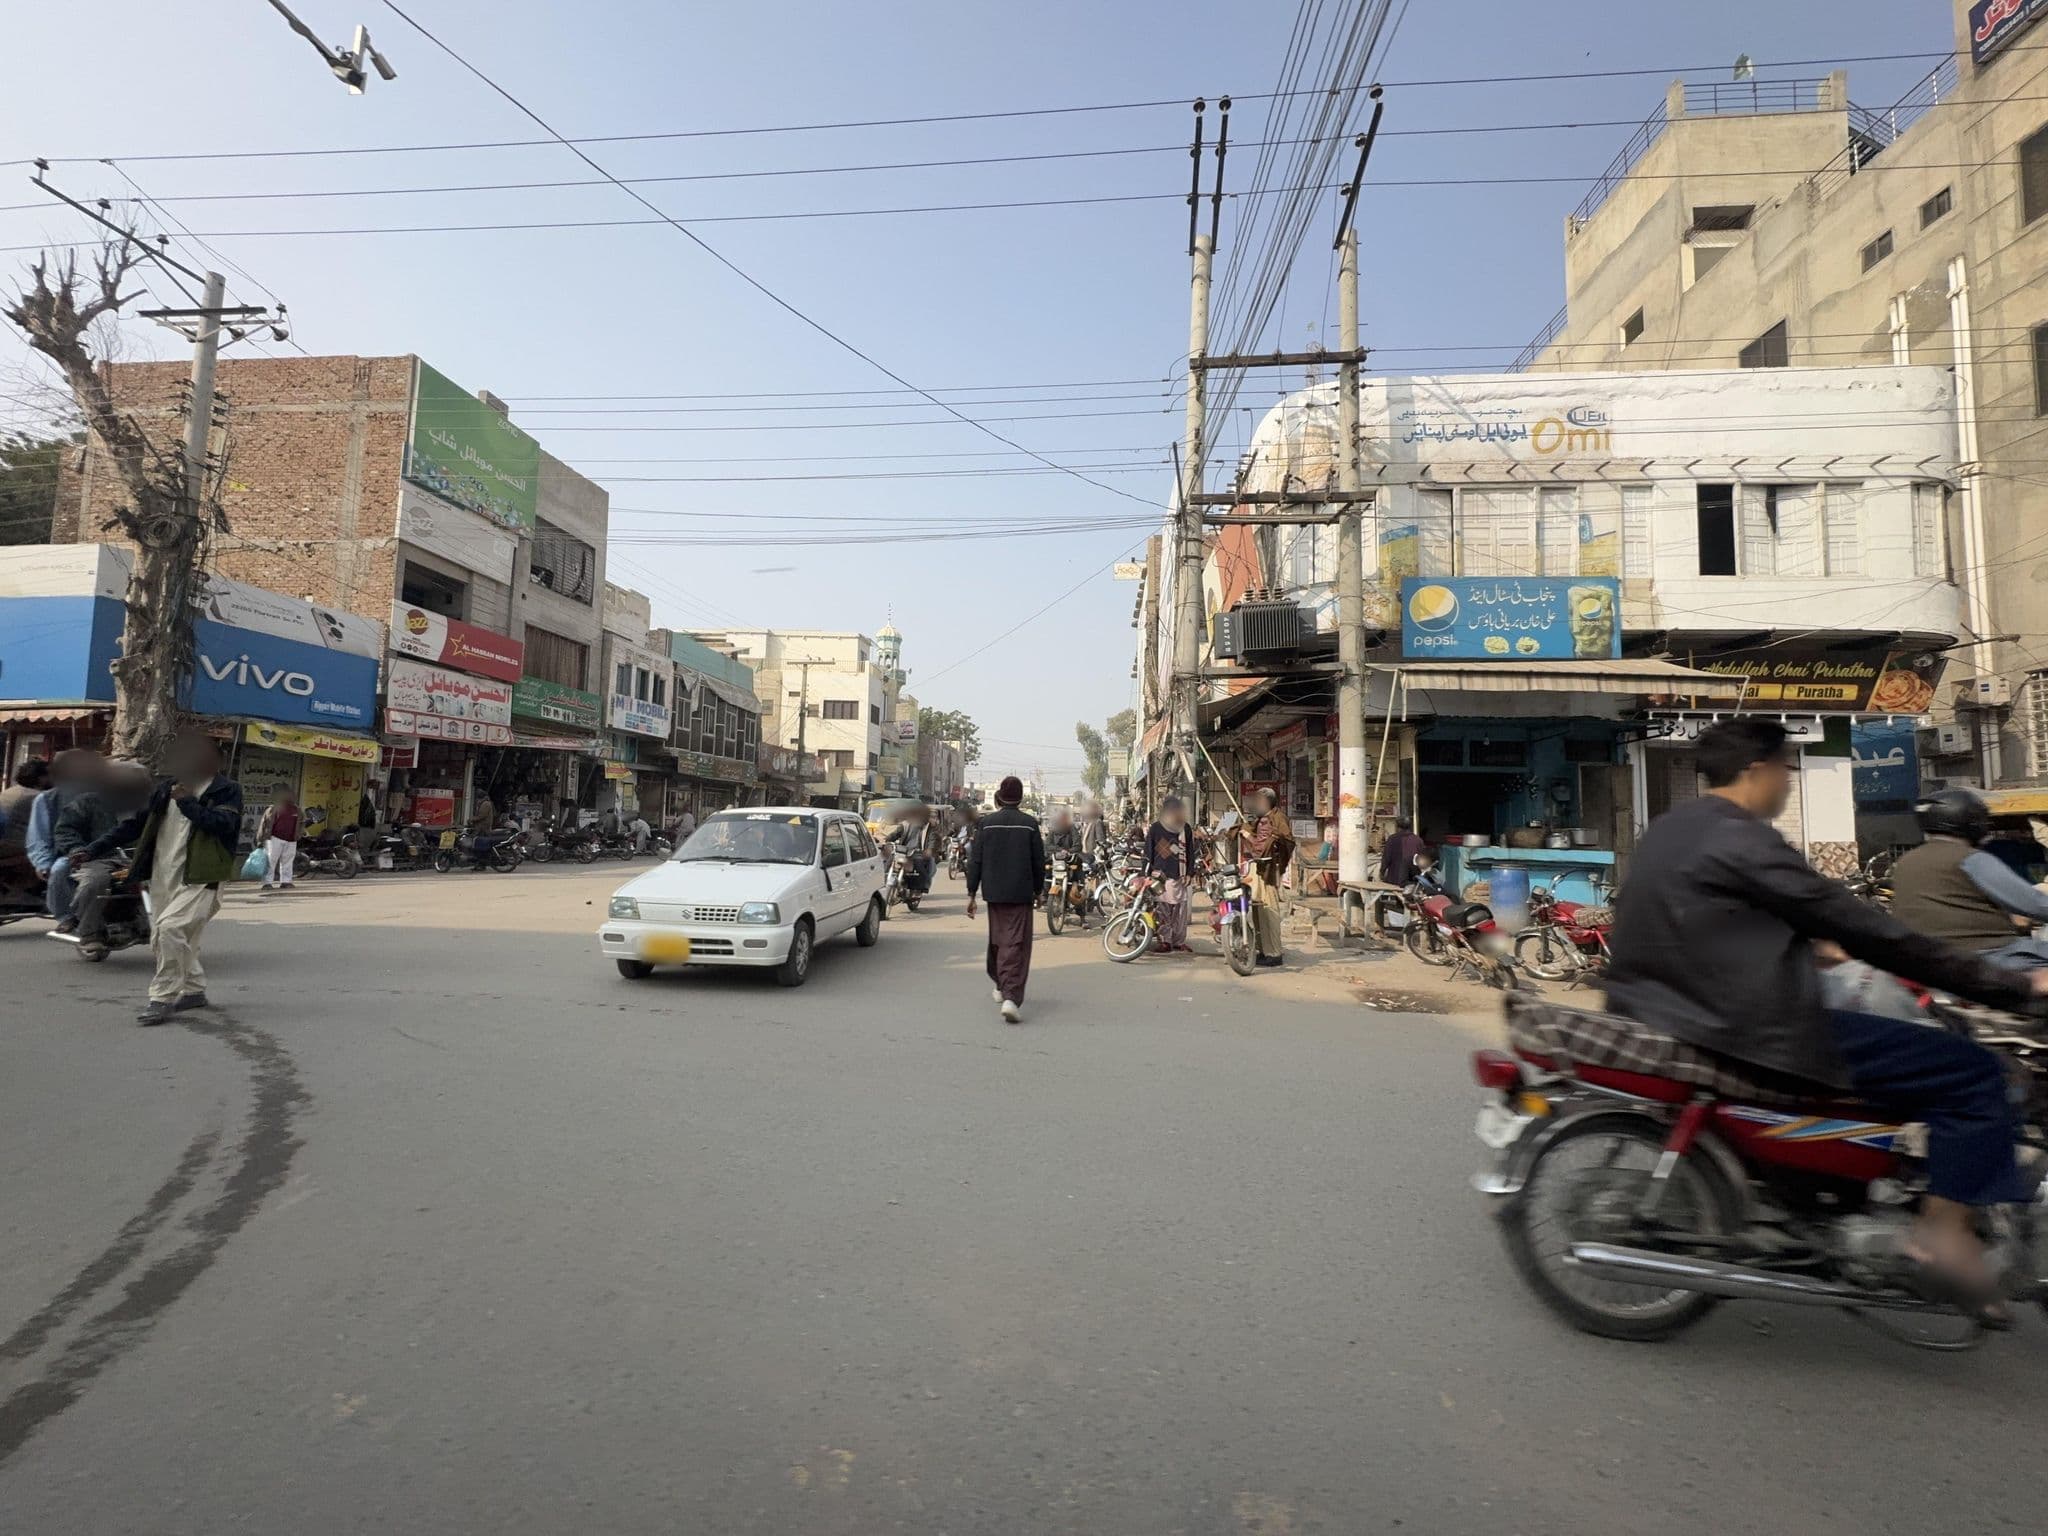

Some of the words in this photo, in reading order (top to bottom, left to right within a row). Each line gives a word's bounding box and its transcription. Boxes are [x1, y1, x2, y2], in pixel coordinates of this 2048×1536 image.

[460, 445, 493, 472] موبائل
[1522, 587, 1556, 607] پنجاب
[1495, 608, 1520, 631] بریانی
[1519, 613, 1541, 630] خان
[1413, 633, 1454, 648] pepsi
[200, 654, 314, 696] vivo
[1702, 660, 1770, 677] Abdullah
[1773, 660, 1810, 678] Chai
[1811, 660, 1877, 679] Puratha
[424, 671, 471, 698] موبائل
[470, 683, 511, 704] الحسن
[1797, 685, 1843, 699] Puratha
